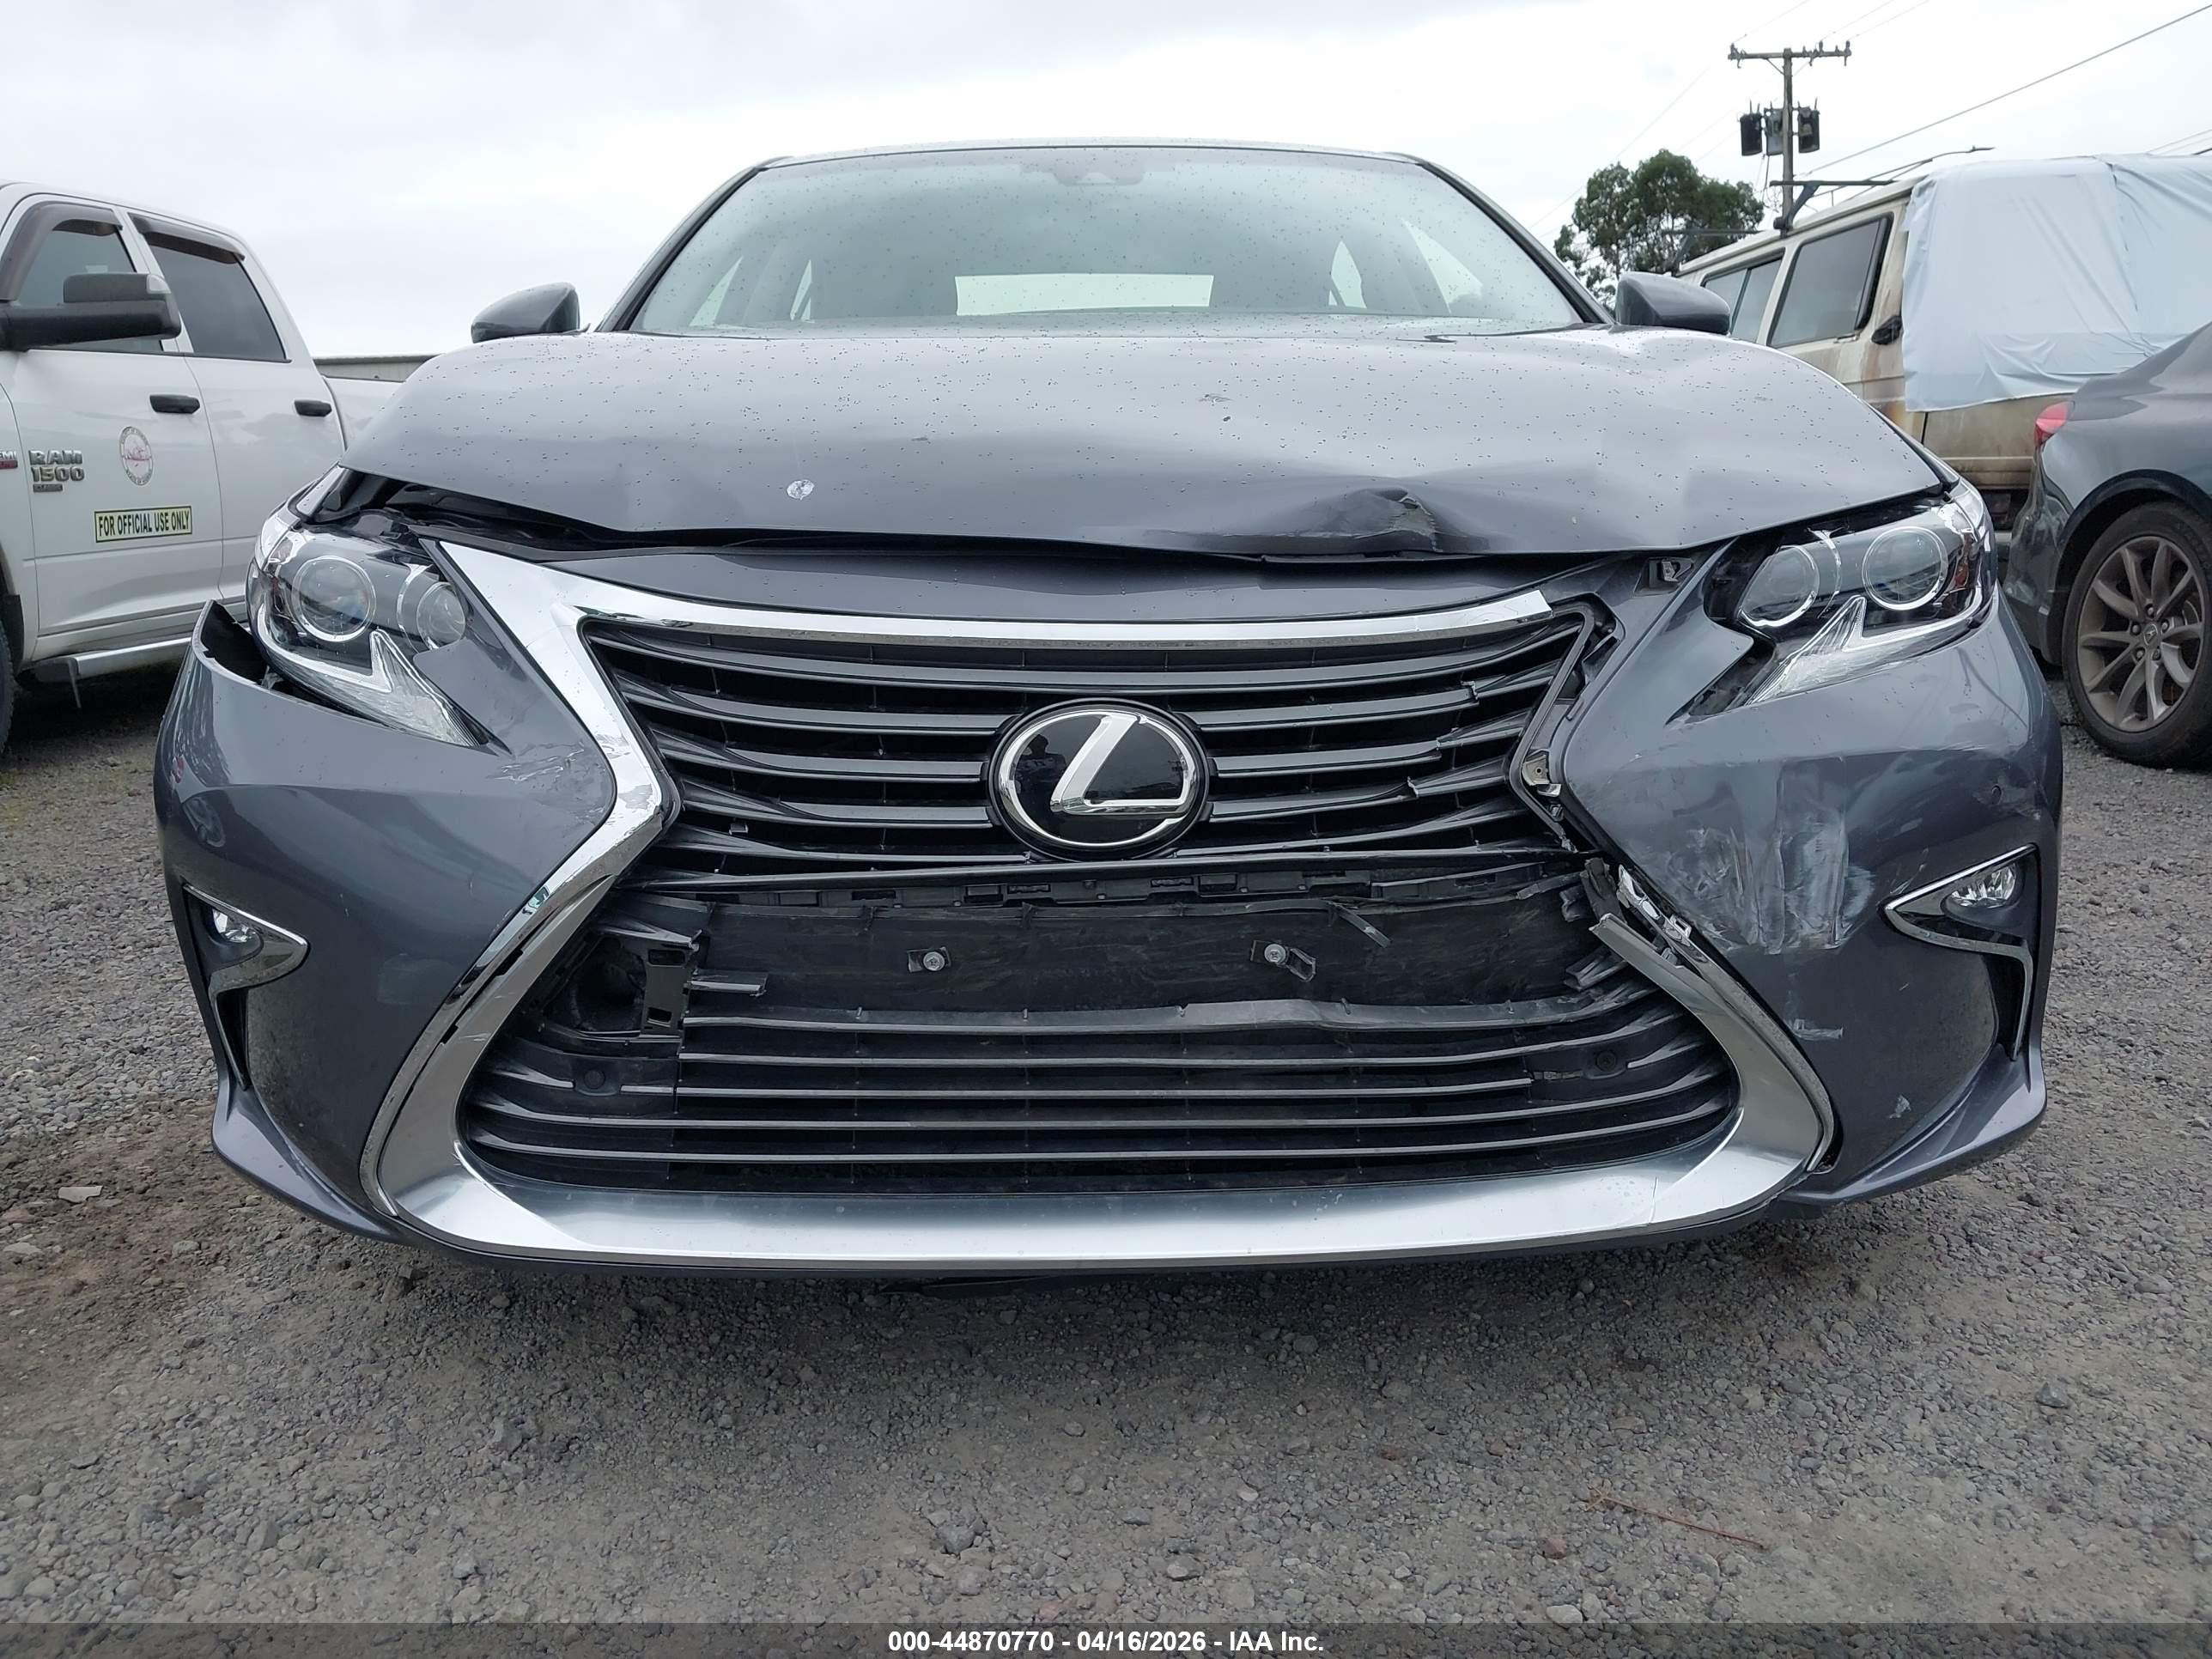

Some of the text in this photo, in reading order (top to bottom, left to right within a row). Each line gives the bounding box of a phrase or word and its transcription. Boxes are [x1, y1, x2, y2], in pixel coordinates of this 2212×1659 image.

[28, 450, 82, 465] RAM
[31, 466, 84, 482] 1500
[99, 510, 190, 537] FOR OFFICIAL USE ONLY
